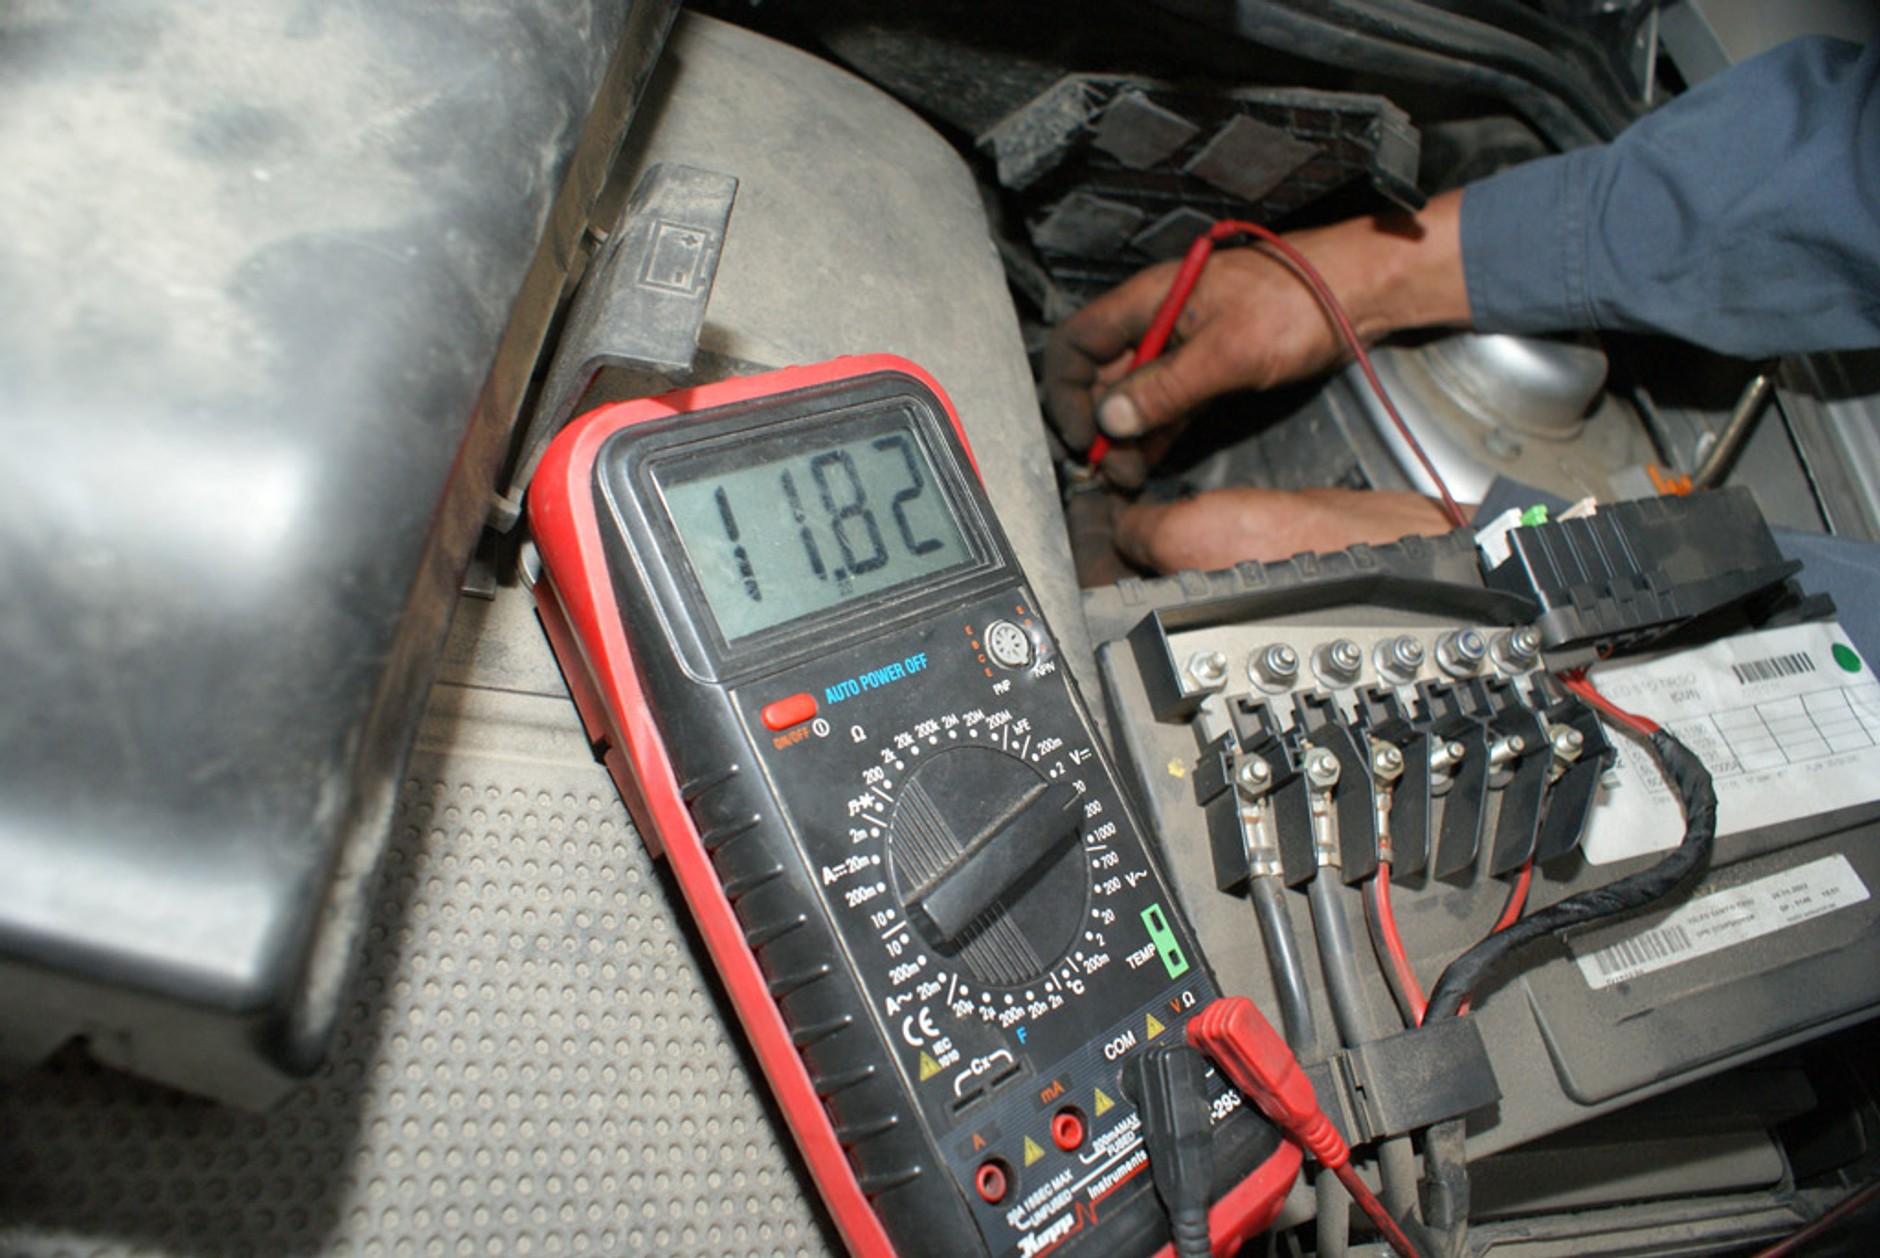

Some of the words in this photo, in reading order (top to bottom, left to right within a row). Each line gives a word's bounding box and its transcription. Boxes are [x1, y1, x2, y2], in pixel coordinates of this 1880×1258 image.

[714, 435, 944, 602] 11.82
[824, 678, 860, 705] AUTO
[859, 662, 906, 692] POWER
[904, 652, 928, 675] OFF
[1037, 737, 1063, 756] 200m
[862, 766, 884, 785] 200
[1056, 761, 1066, 775] 2
[1084, 800, 1103, 818] 200
[1094, 822, 1117, 842] 1000
[1100, 851, 1119, 869] 700
[1103, 876, 1122, 896] 200
[845, 886, 877, 908] 200m
[870, 911, 888, 929] 10
[1101, 909, 1116, 925] 20
[885, 940, 902, 958] 10
[1096, 933, 1106, 947] 2
[1083, 953, 1111, 975] 200m
[1125, 942, 1156, 969] TEMP
[902, 1005, 940, 1047] CE
[1016, 1026, 1027, 1044] F
[1104, 1030, 1137, 1060] COM
[1040, 1080, 1065, 1105] mA
[972, 1132, 986, 1152] A
[1051, 1168, 1074, 1192] MAX
[1087, 1149, 1148, 1199] Instruments
